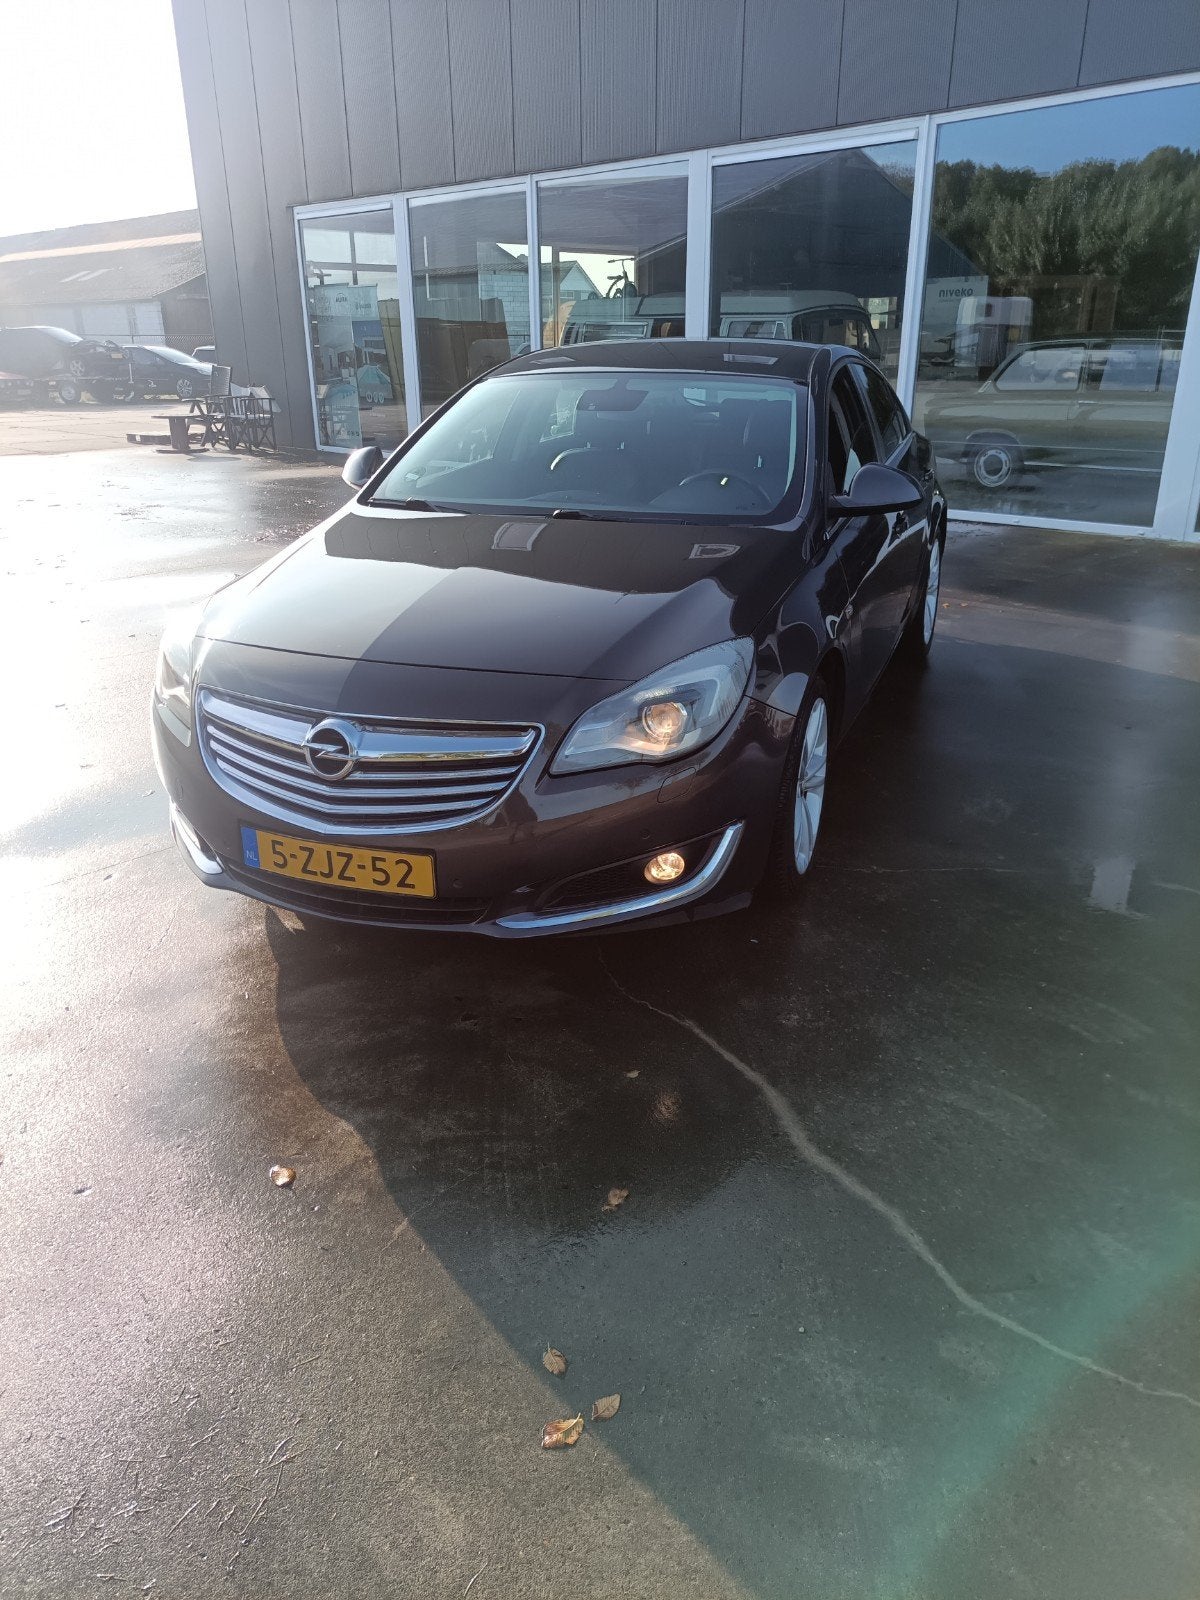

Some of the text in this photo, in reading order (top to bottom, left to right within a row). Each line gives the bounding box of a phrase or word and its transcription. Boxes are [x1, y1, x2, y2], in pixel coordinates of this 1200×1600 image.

[938, 287, 974, 298] niveko
[246, 850, 258, 861] NL
[271, 839, 416, 889] 5-ZJZ-52
